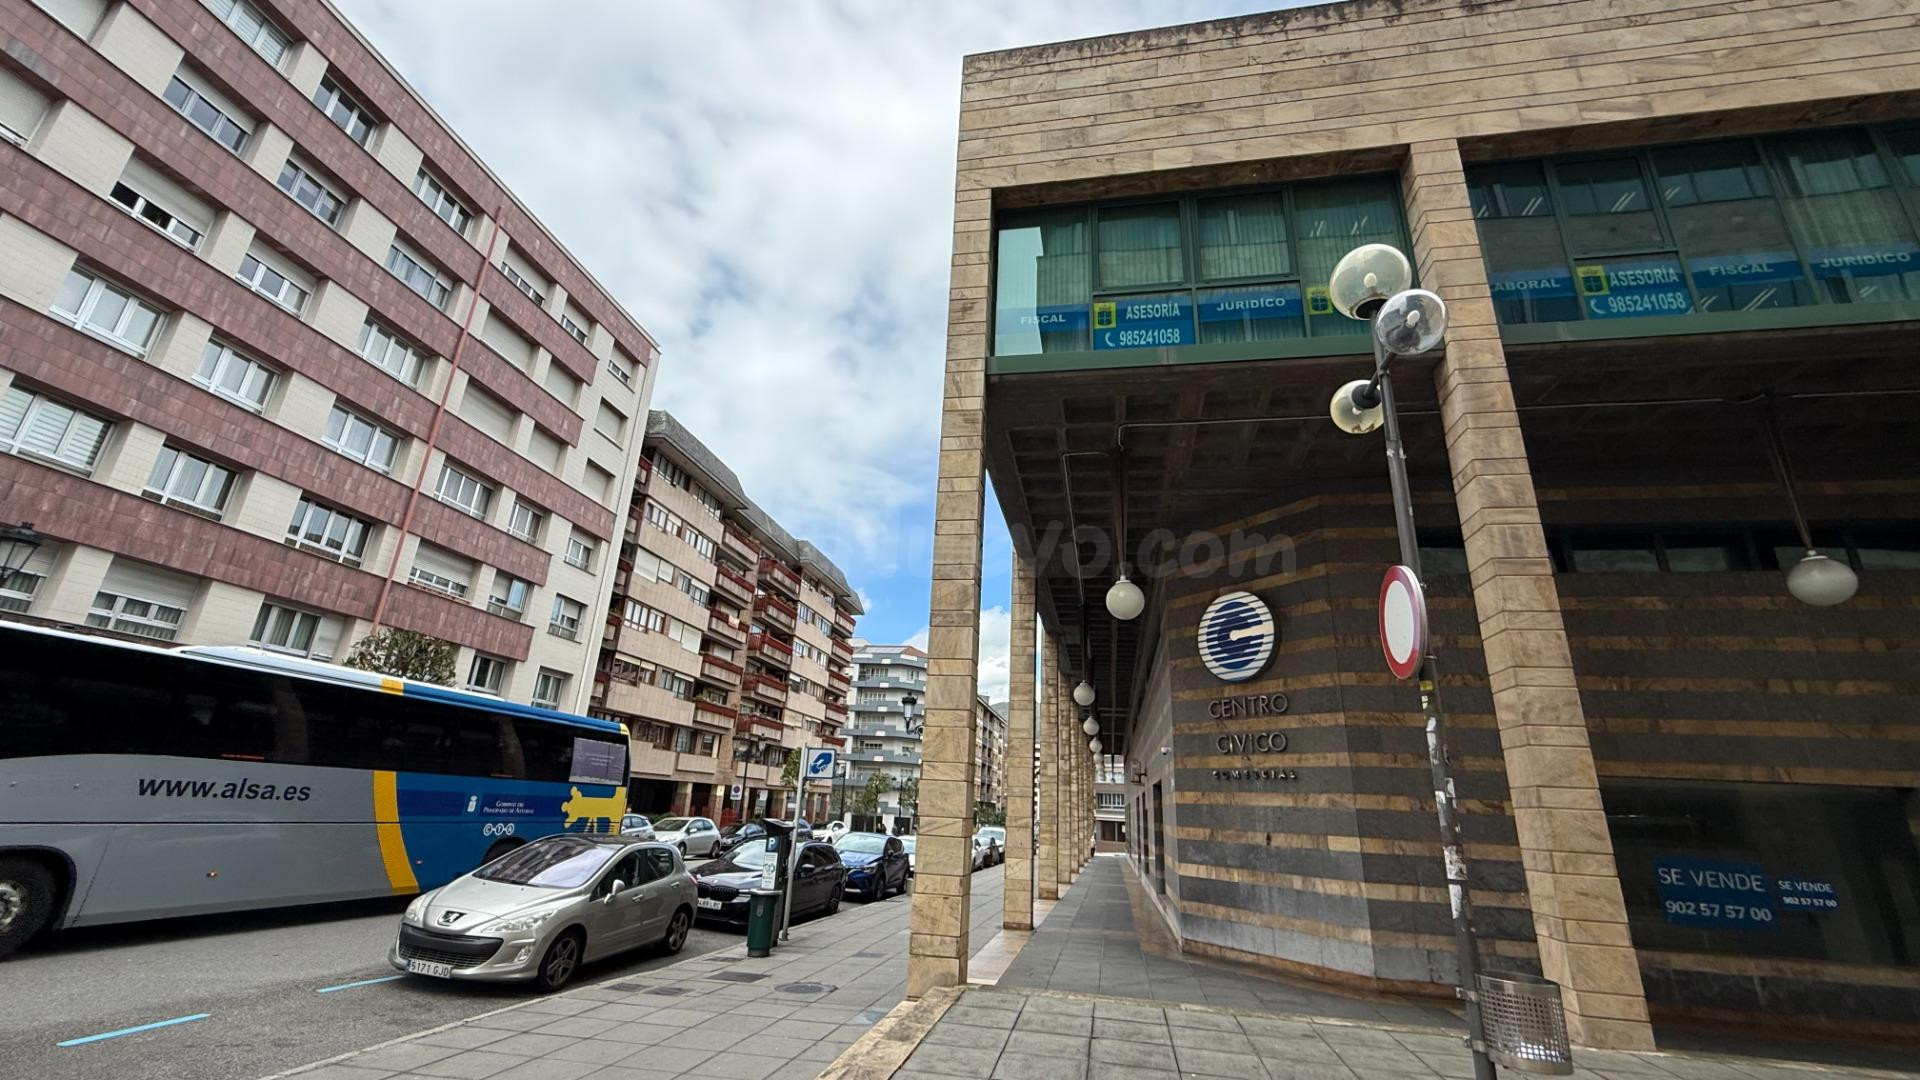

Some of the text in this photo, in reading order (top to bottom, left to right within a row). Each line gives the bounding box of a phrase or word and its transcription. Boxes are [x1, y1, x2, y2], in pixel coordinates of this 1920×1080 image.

[1610, 265, 1680, 287] ASESORÍA
[1709, 263, 1774, 276] FISCAL
[1491, 279, 1561, 291] ABORAL
[1126, 301, 1181, 320] ASESORÍA
[1607, 292, 1686, 313] 985241058
[1020, 314, 1067, 325] FISCAL
[1120, 328, 1181, 346] 985241058
[1208, 693, 1289, 719] CENTRO
[1216, 731, 1288, 755] CIVICO
[138, 777, 312, 802] www.alsa.es
[768, 836, 776, 849] P
[1658, 867, 1766, 892] SE VENDE
[1778, 880, 1834, 893] SE VENDE
[1665, 900, 1773, 922] 902 57 57 00
[411, 961, 450, 977] 5171 GJD
